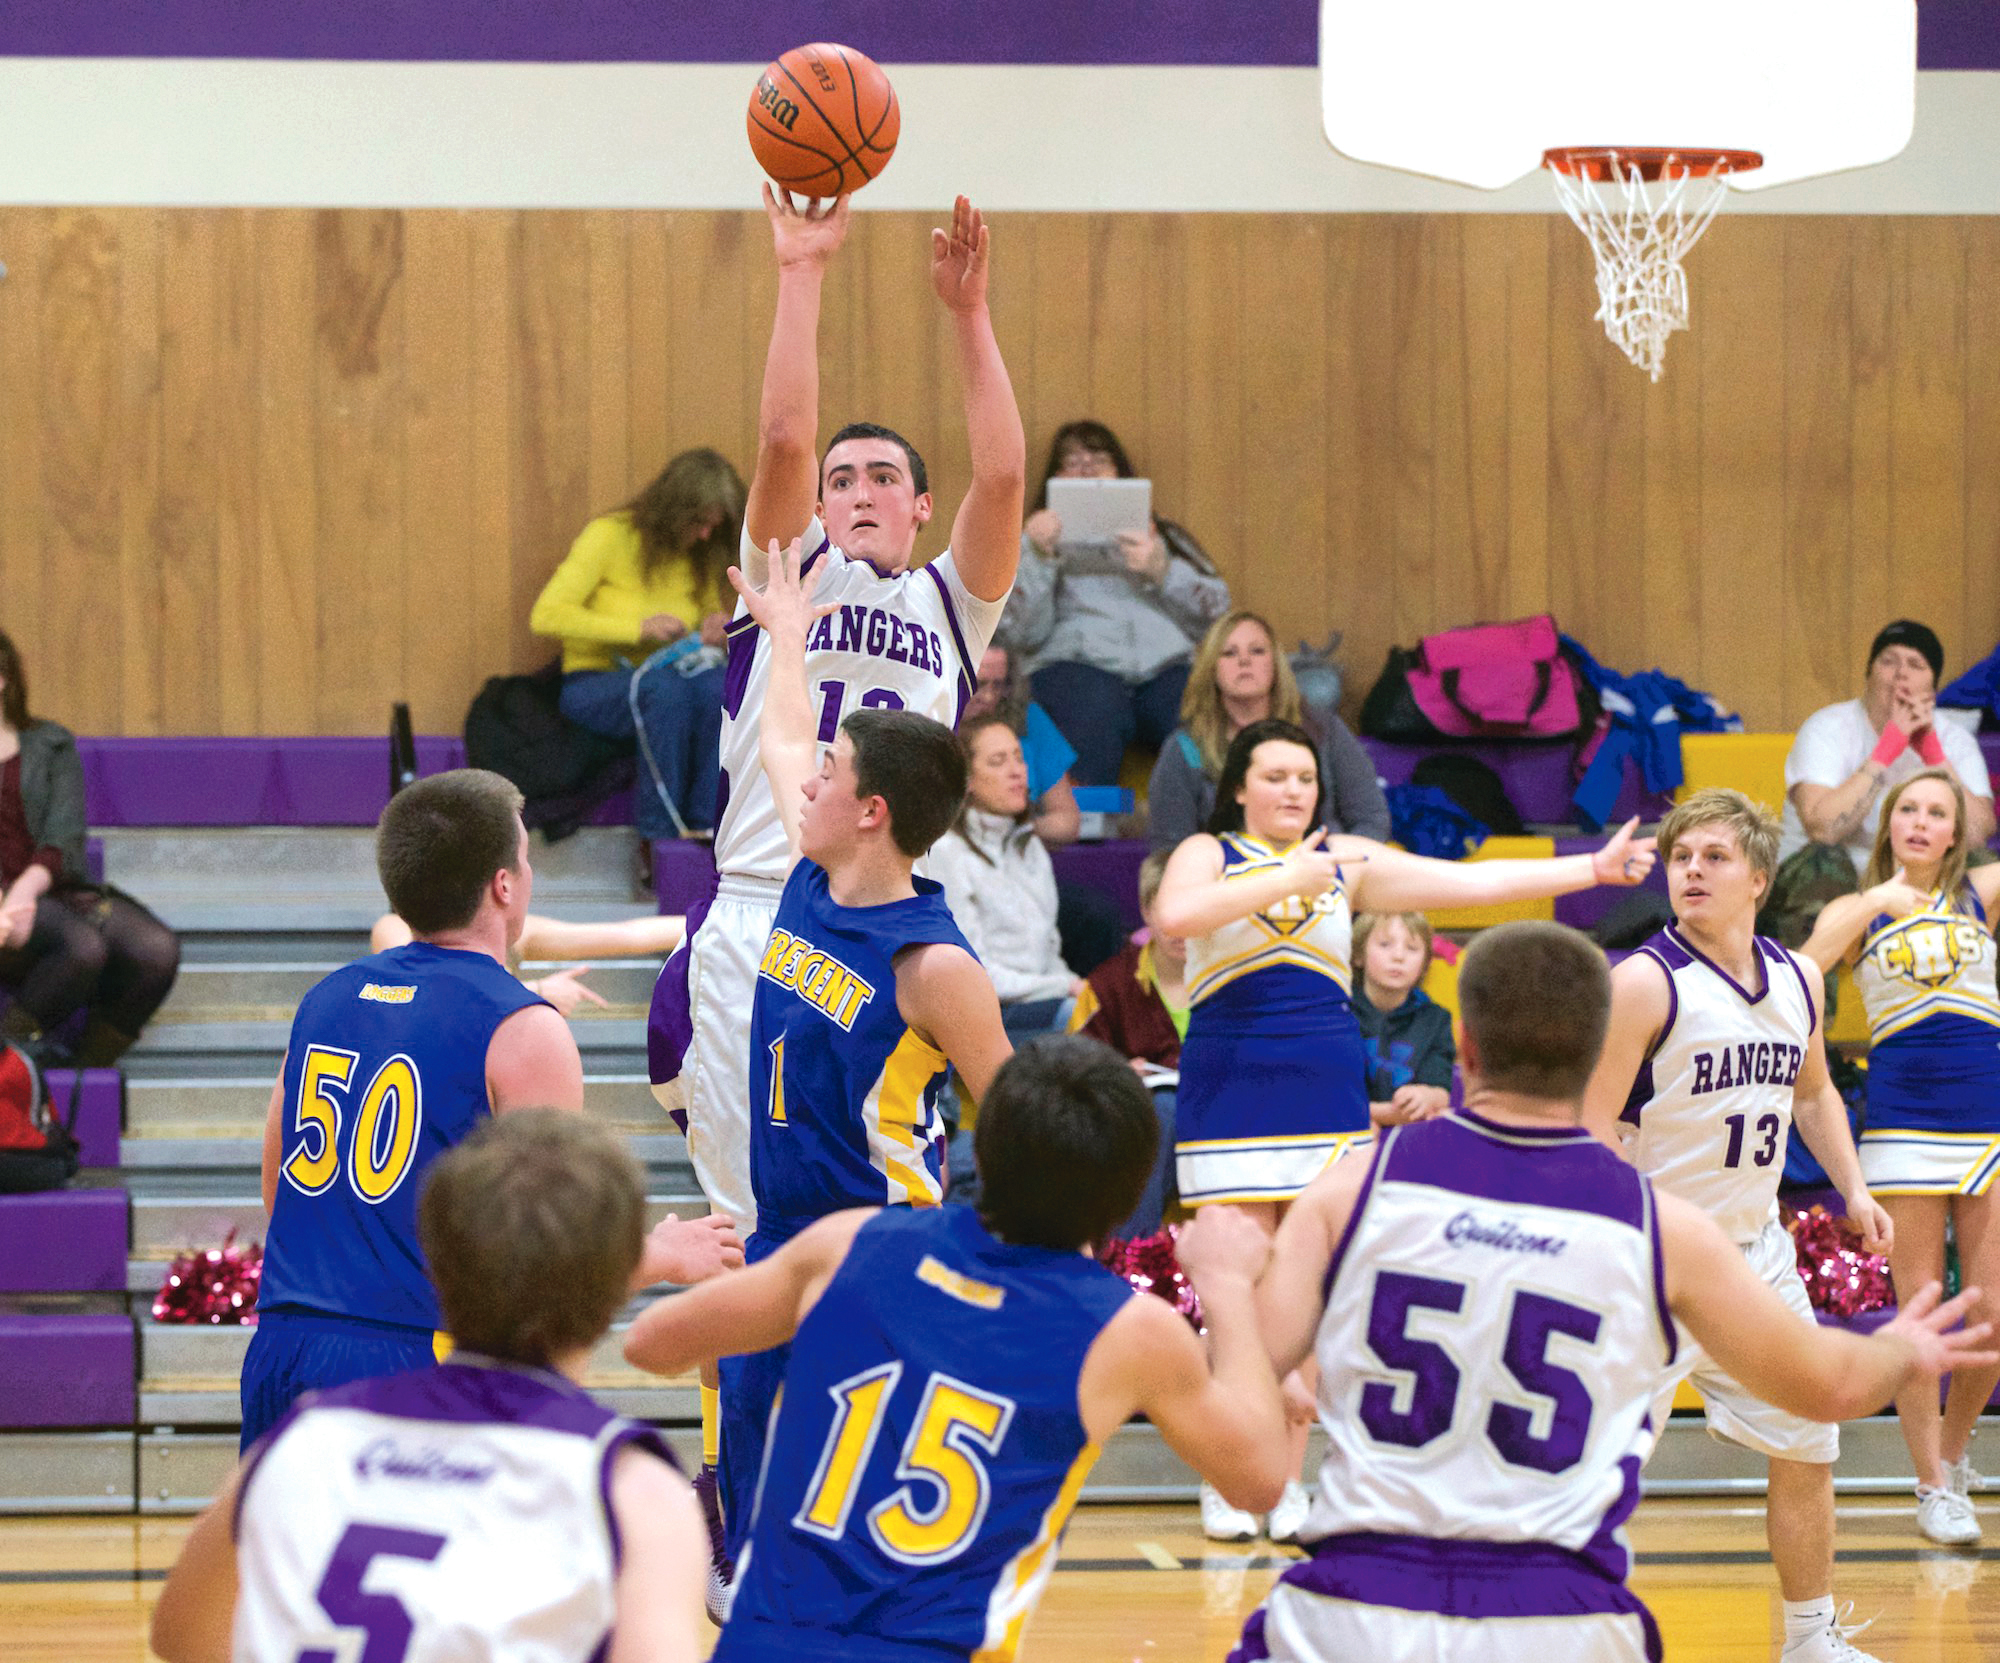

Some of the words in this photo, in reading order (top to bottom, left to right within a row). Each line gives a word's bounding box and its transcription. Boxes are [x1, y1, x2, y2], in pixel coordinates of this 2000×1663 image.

[805, 605, 943, 679] ANGERS
[759, 927, 876, 1033] RESCENT
[1876, 924, 1983, 980] CHS
[768, 1029, 789, 1128] 1
[1691, 1042, 1801, 1096] RANGER
[281, 1043, 423, 1205] 50
[1723, 1113, 1780, 1168] 13
[1359, 1270, 1604, 1476] 55
[791, 1359, 1017, 1566] 15
[297, 1522, 447, 1663] 5
